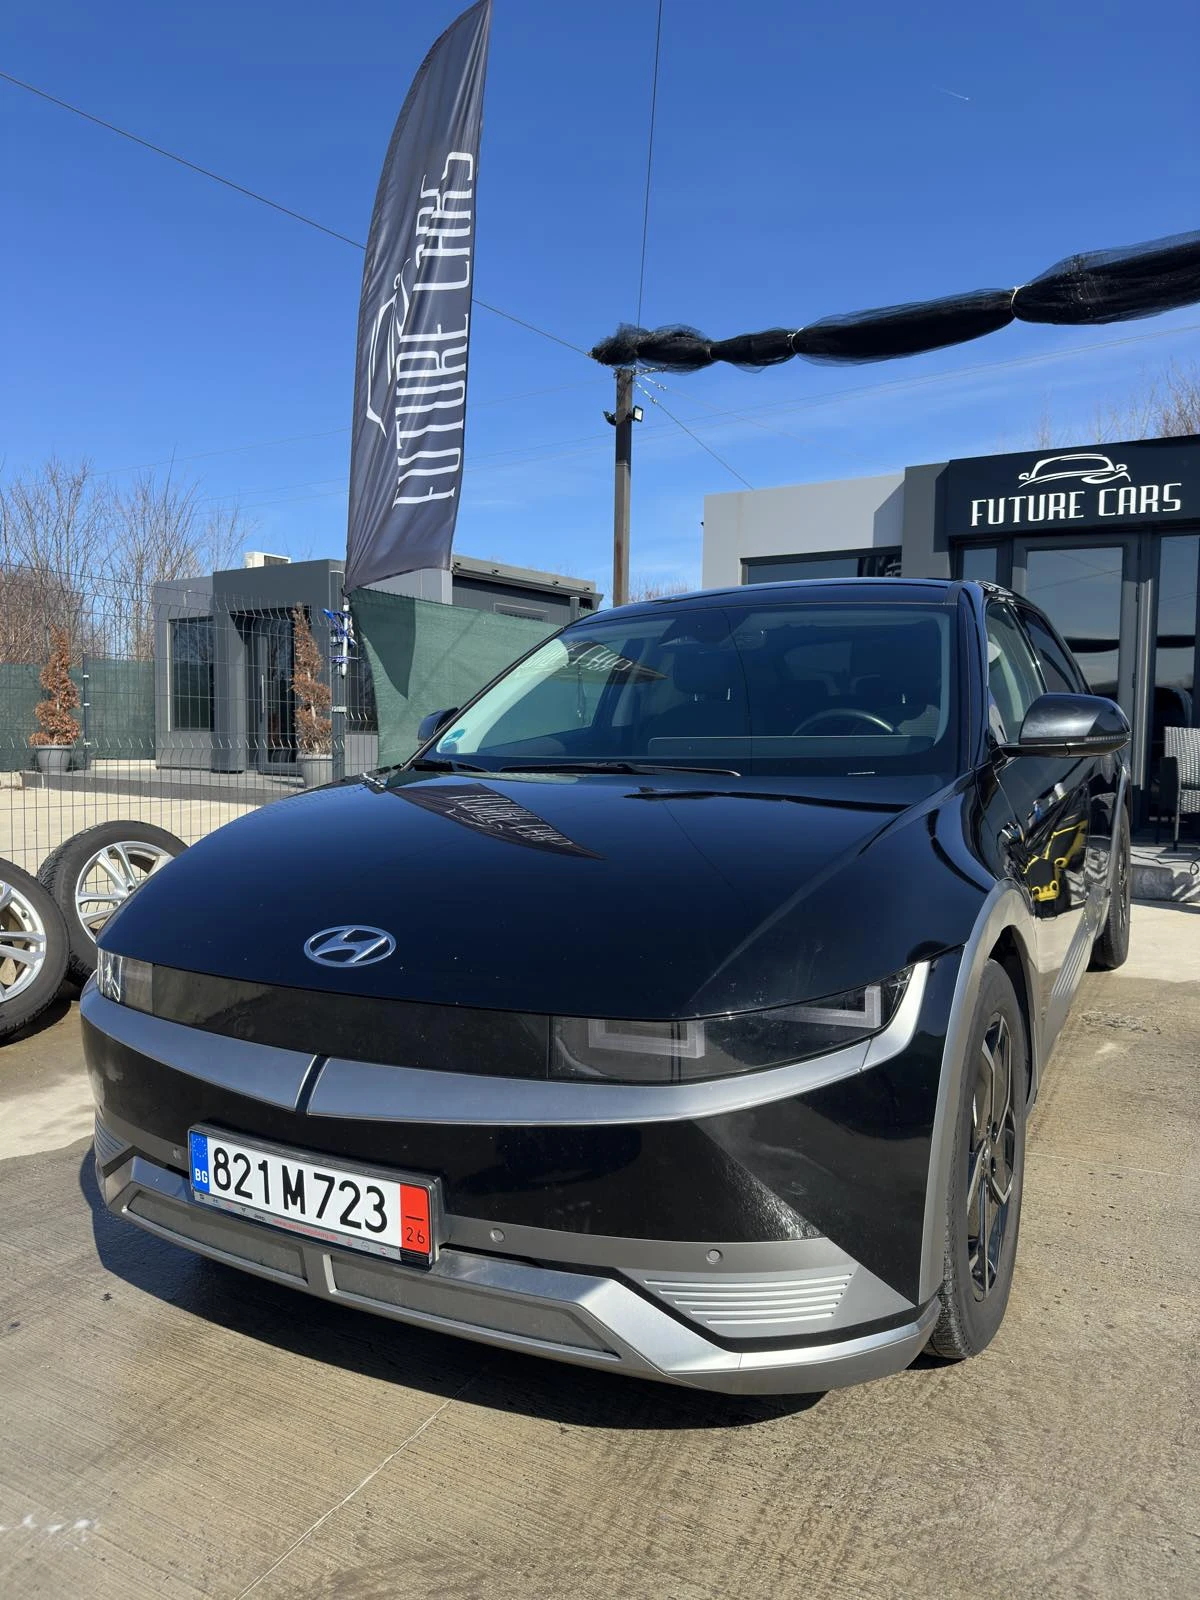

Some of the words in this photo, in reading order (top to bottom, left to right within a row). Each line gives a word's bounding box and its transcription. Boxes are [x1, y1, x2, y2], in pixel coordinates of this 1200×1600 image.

[412, 151, 474, 291] CARS
[391, 313, 469, 509] FUTURE
[970, 490, 1086, 527] FUTURE
[1098, 482, 1182, 517] CARS
[194, 1168, 209, 1184] BG
[405, 1226, 426, 1245] 26
